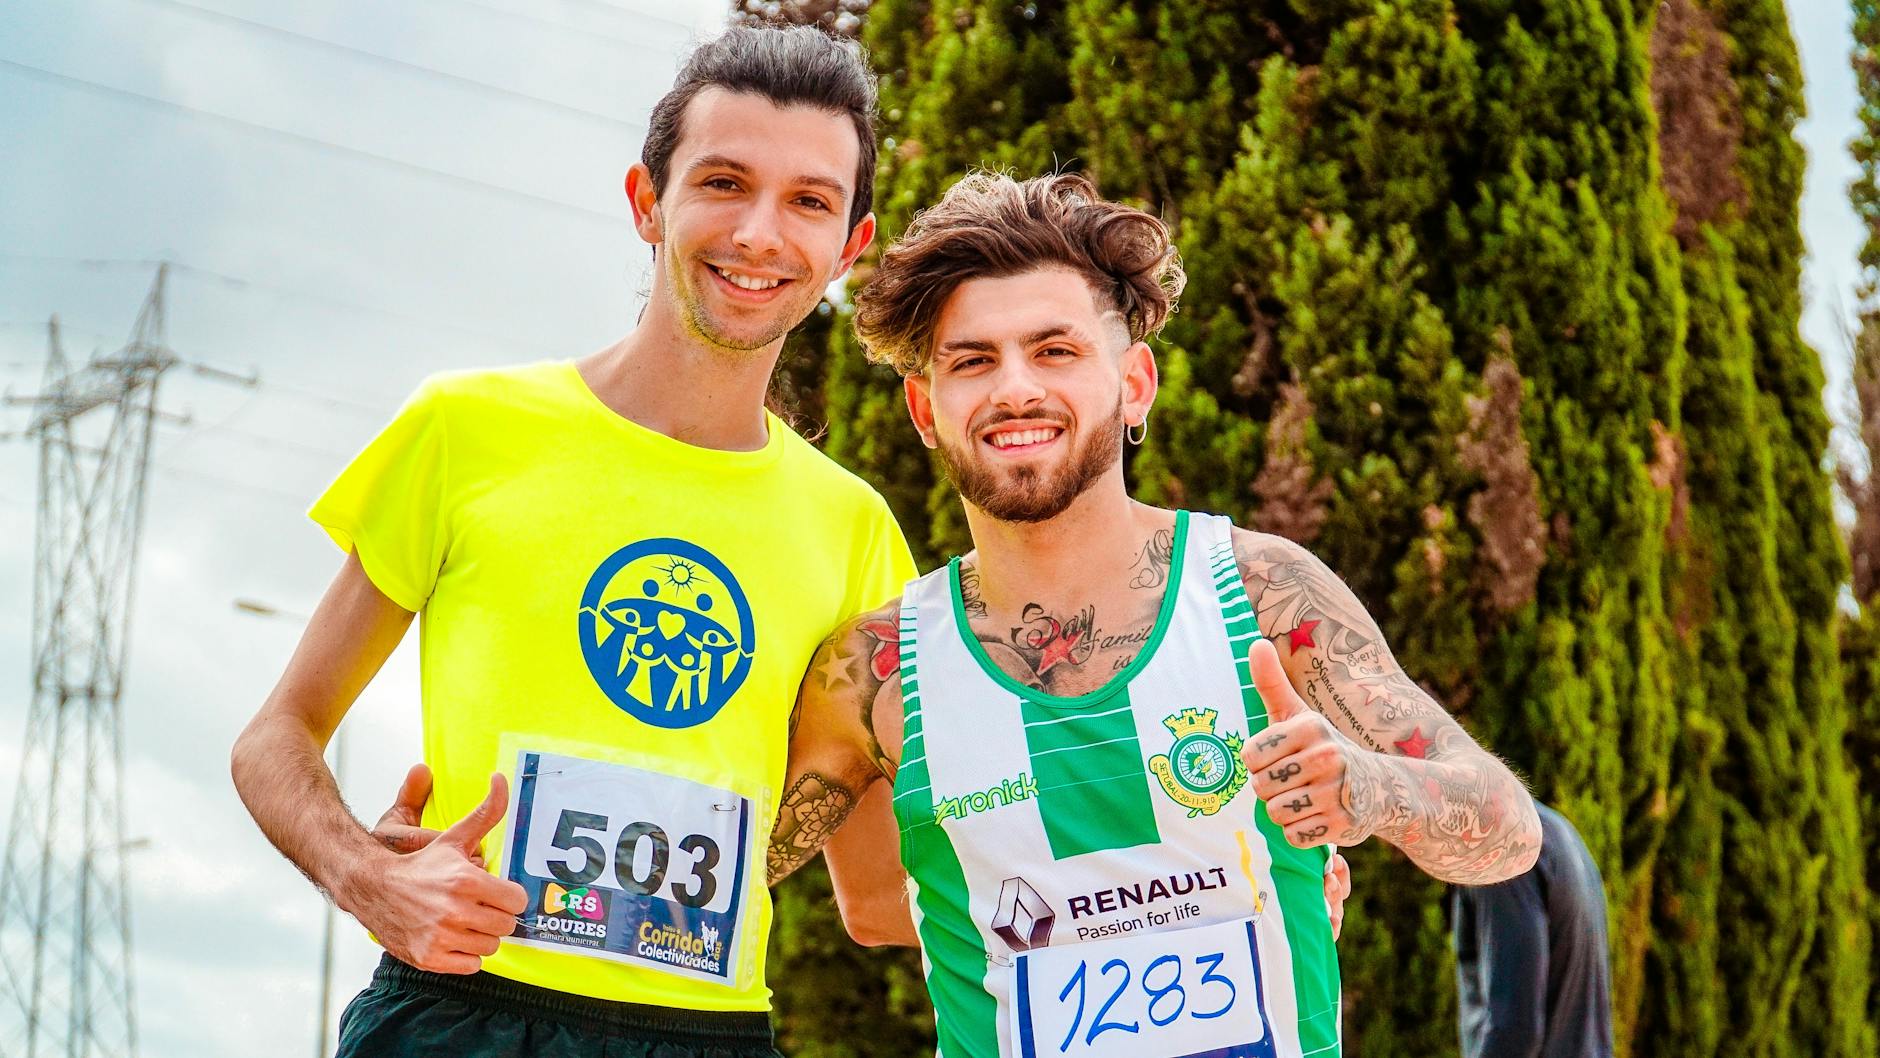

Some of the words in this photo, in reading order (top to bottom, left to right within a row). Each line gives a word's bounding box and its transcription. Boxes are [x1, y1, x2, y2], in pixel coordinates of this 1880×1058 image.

[1068, 625, 1153, 665] famil
[932, 772, 1040, 825] Aronick
[546, 809, 720, 908] 503
[553, 892, 597, 912] LRS
[1067, 866, 1228, 919] RENAULT
[536, 915, 607, 938] LOURES
[639, 921, 703, 955] Corrida
[1077, 915, 1144, 940] Passion
[1146, 910, 1171, 928] for
[1173, 902, 1201, 920] life
[637, 941, 720, 973] Colectividades
[1059, 952, 1236, 1053] 1283
